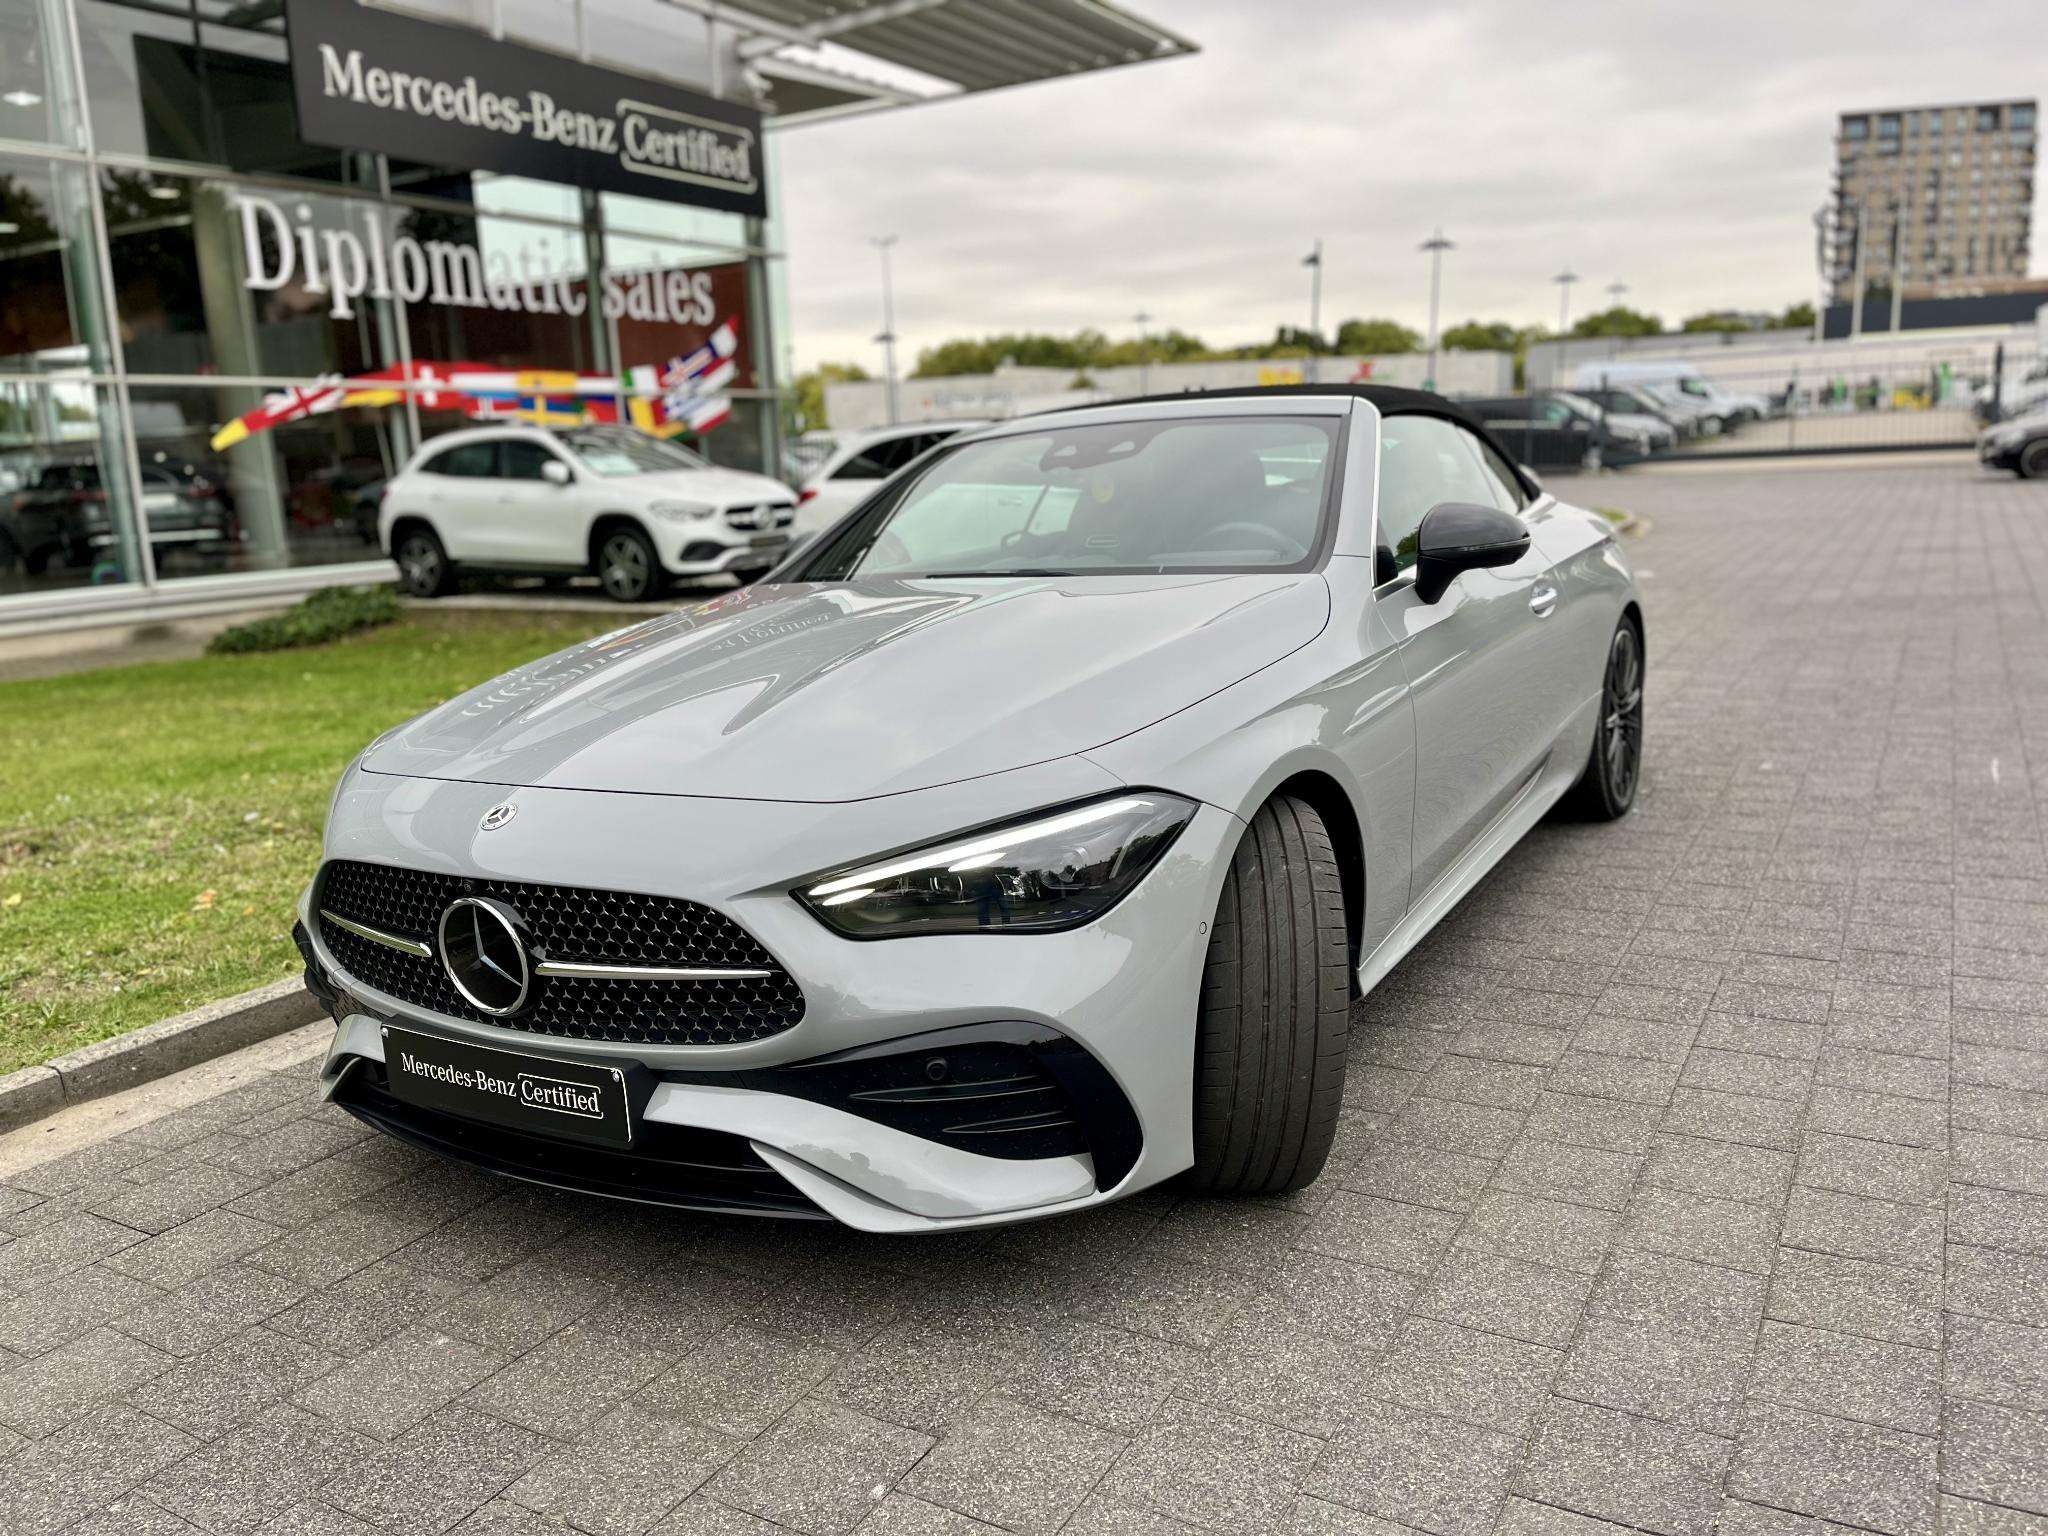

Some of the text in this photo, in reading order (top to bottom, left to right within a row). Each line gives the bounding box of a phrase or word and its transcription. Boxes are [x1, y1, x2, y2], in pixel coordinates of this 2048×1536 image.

[318, 43, 752, 182] Mercedes-Benz Certified
[237, 194, 716, 327] Diplomatic sales
[401, 1052, 600, 1113] Mercedes-Benz Certified
